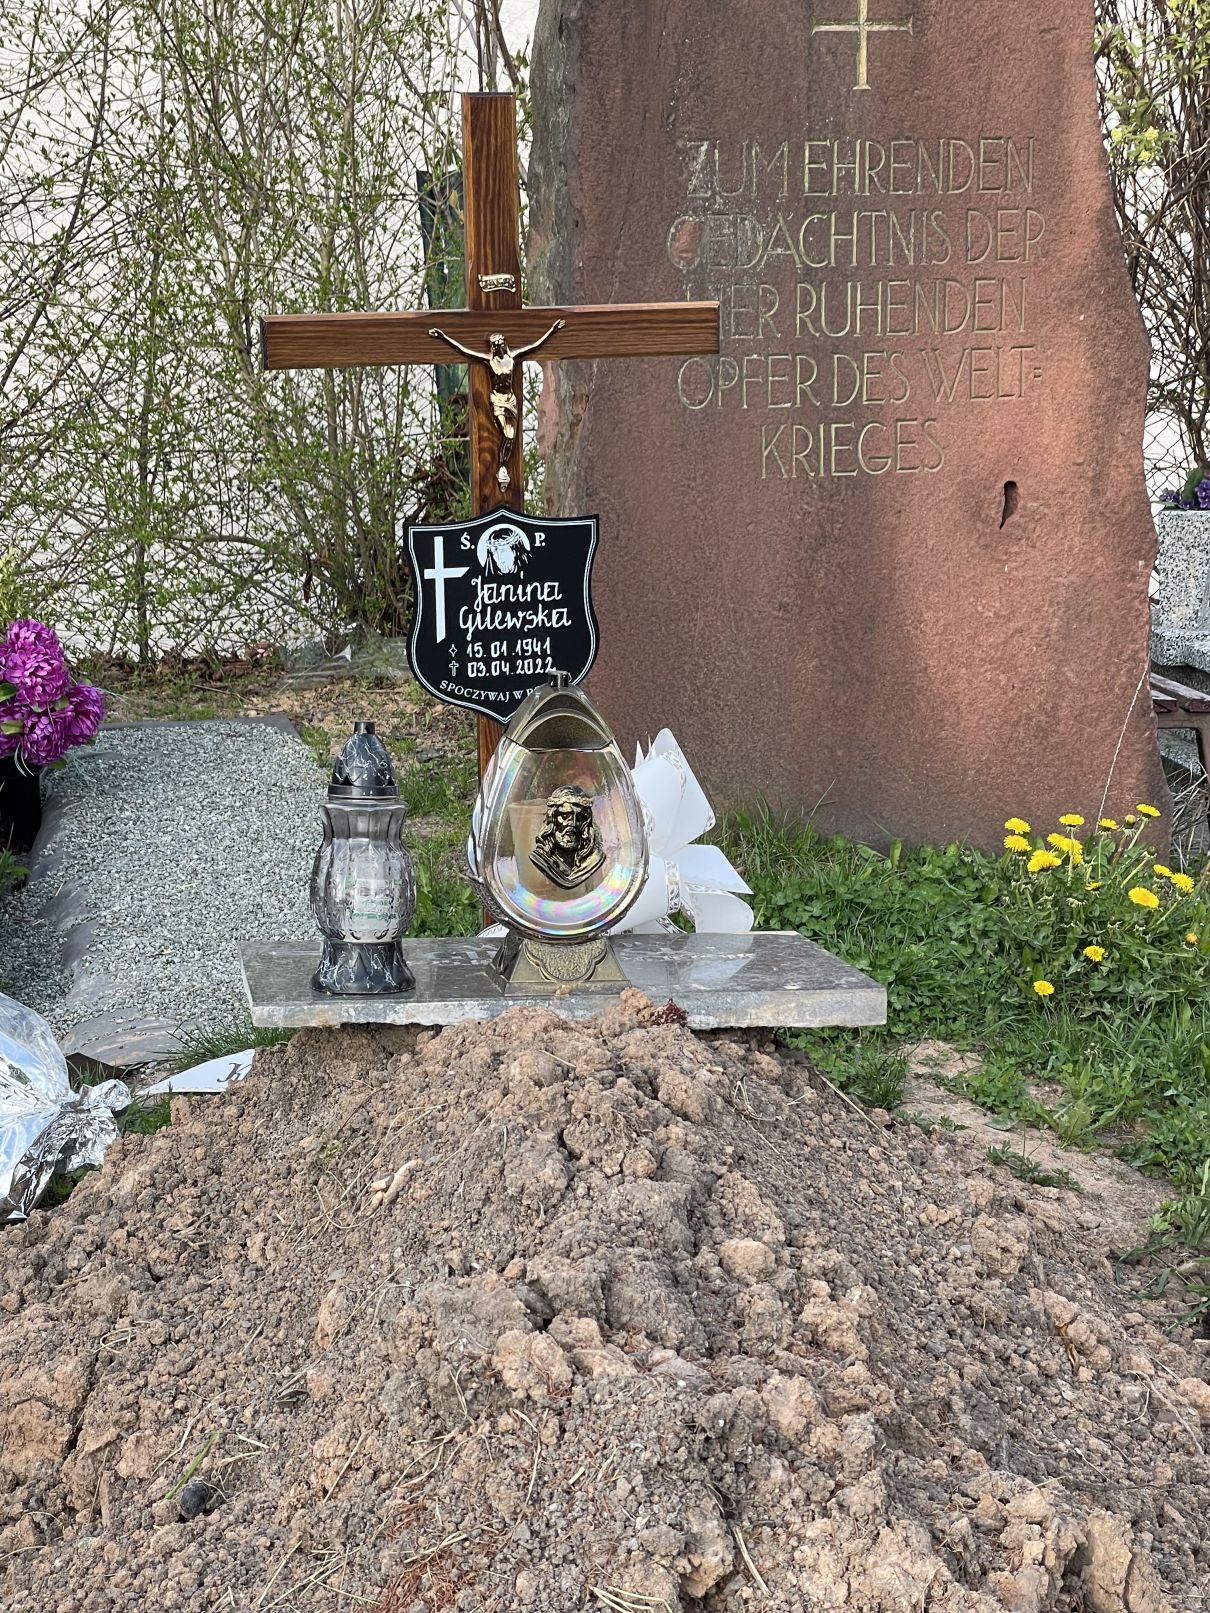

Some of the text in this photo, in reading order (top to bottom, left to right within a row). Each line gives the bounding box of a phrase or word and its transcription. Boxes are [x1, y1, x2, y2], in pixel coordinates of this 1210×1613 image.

[685, 135, 1035, 197] ZUM EHRENDEN
[966, 207, 1046, 264] DER
[795, 275, 1027, 338] RUHENDEN
[677, 352, 822, 409] OPFER
[831, 352, 911, 407] DES
[760, 417, 946, 479] KRIEGES
[534, 532, 546, 547] P.
[471, 570, 563, 611] Janina
[439, 680, 510, 702] SPOCZYWAJ
[513, 689, 524, 700] W
